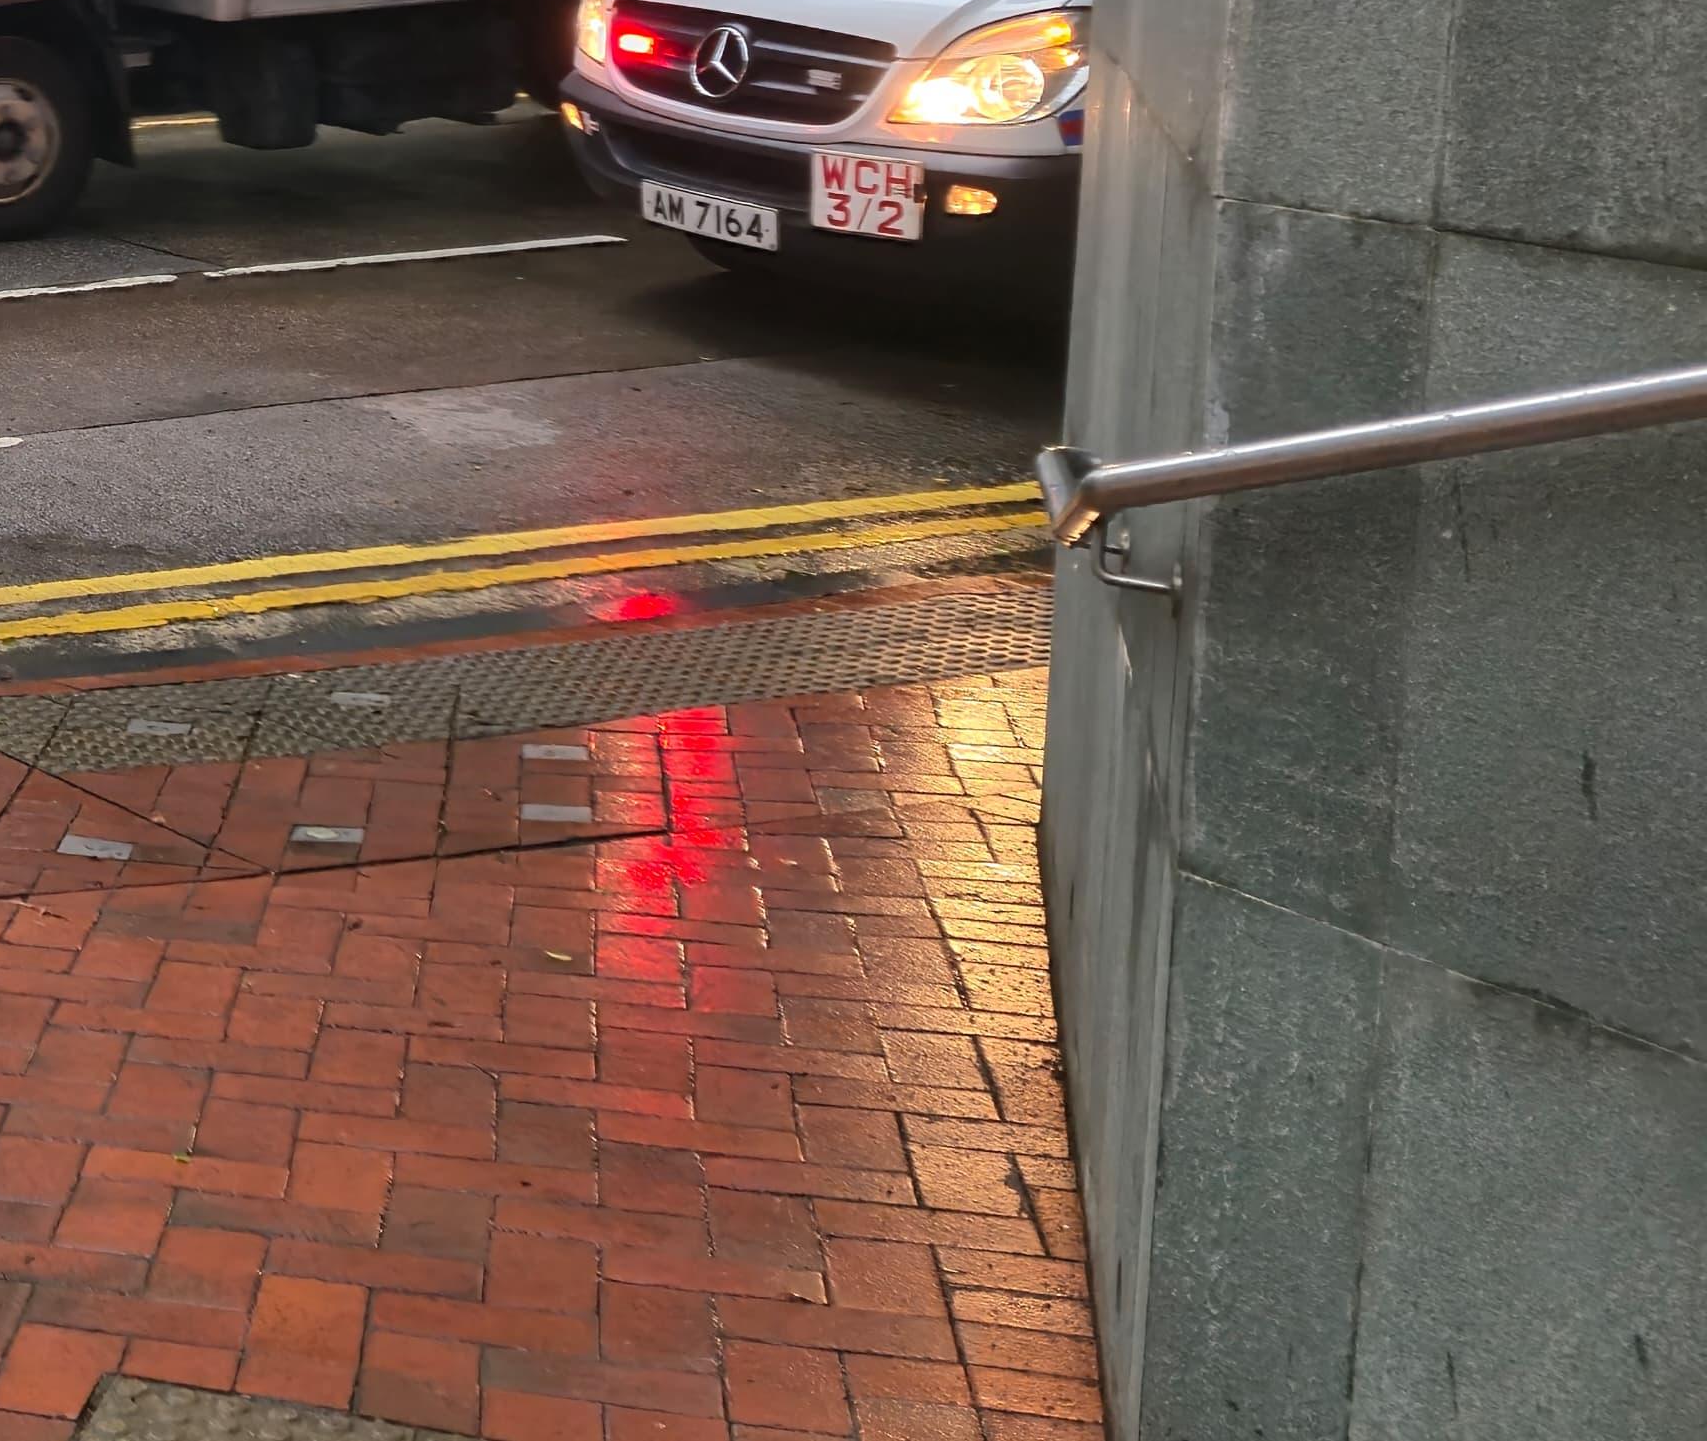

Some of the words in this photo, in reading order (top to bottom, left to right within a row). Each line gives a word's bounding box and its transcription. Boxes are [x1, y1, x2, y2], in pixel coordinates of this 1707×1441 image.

[821, 155, 913, 199] WCH
[653, 190, 685, 226] AM
[695, 200, 764, 243] 7164
[827, 192, 905, 236] 3/2
